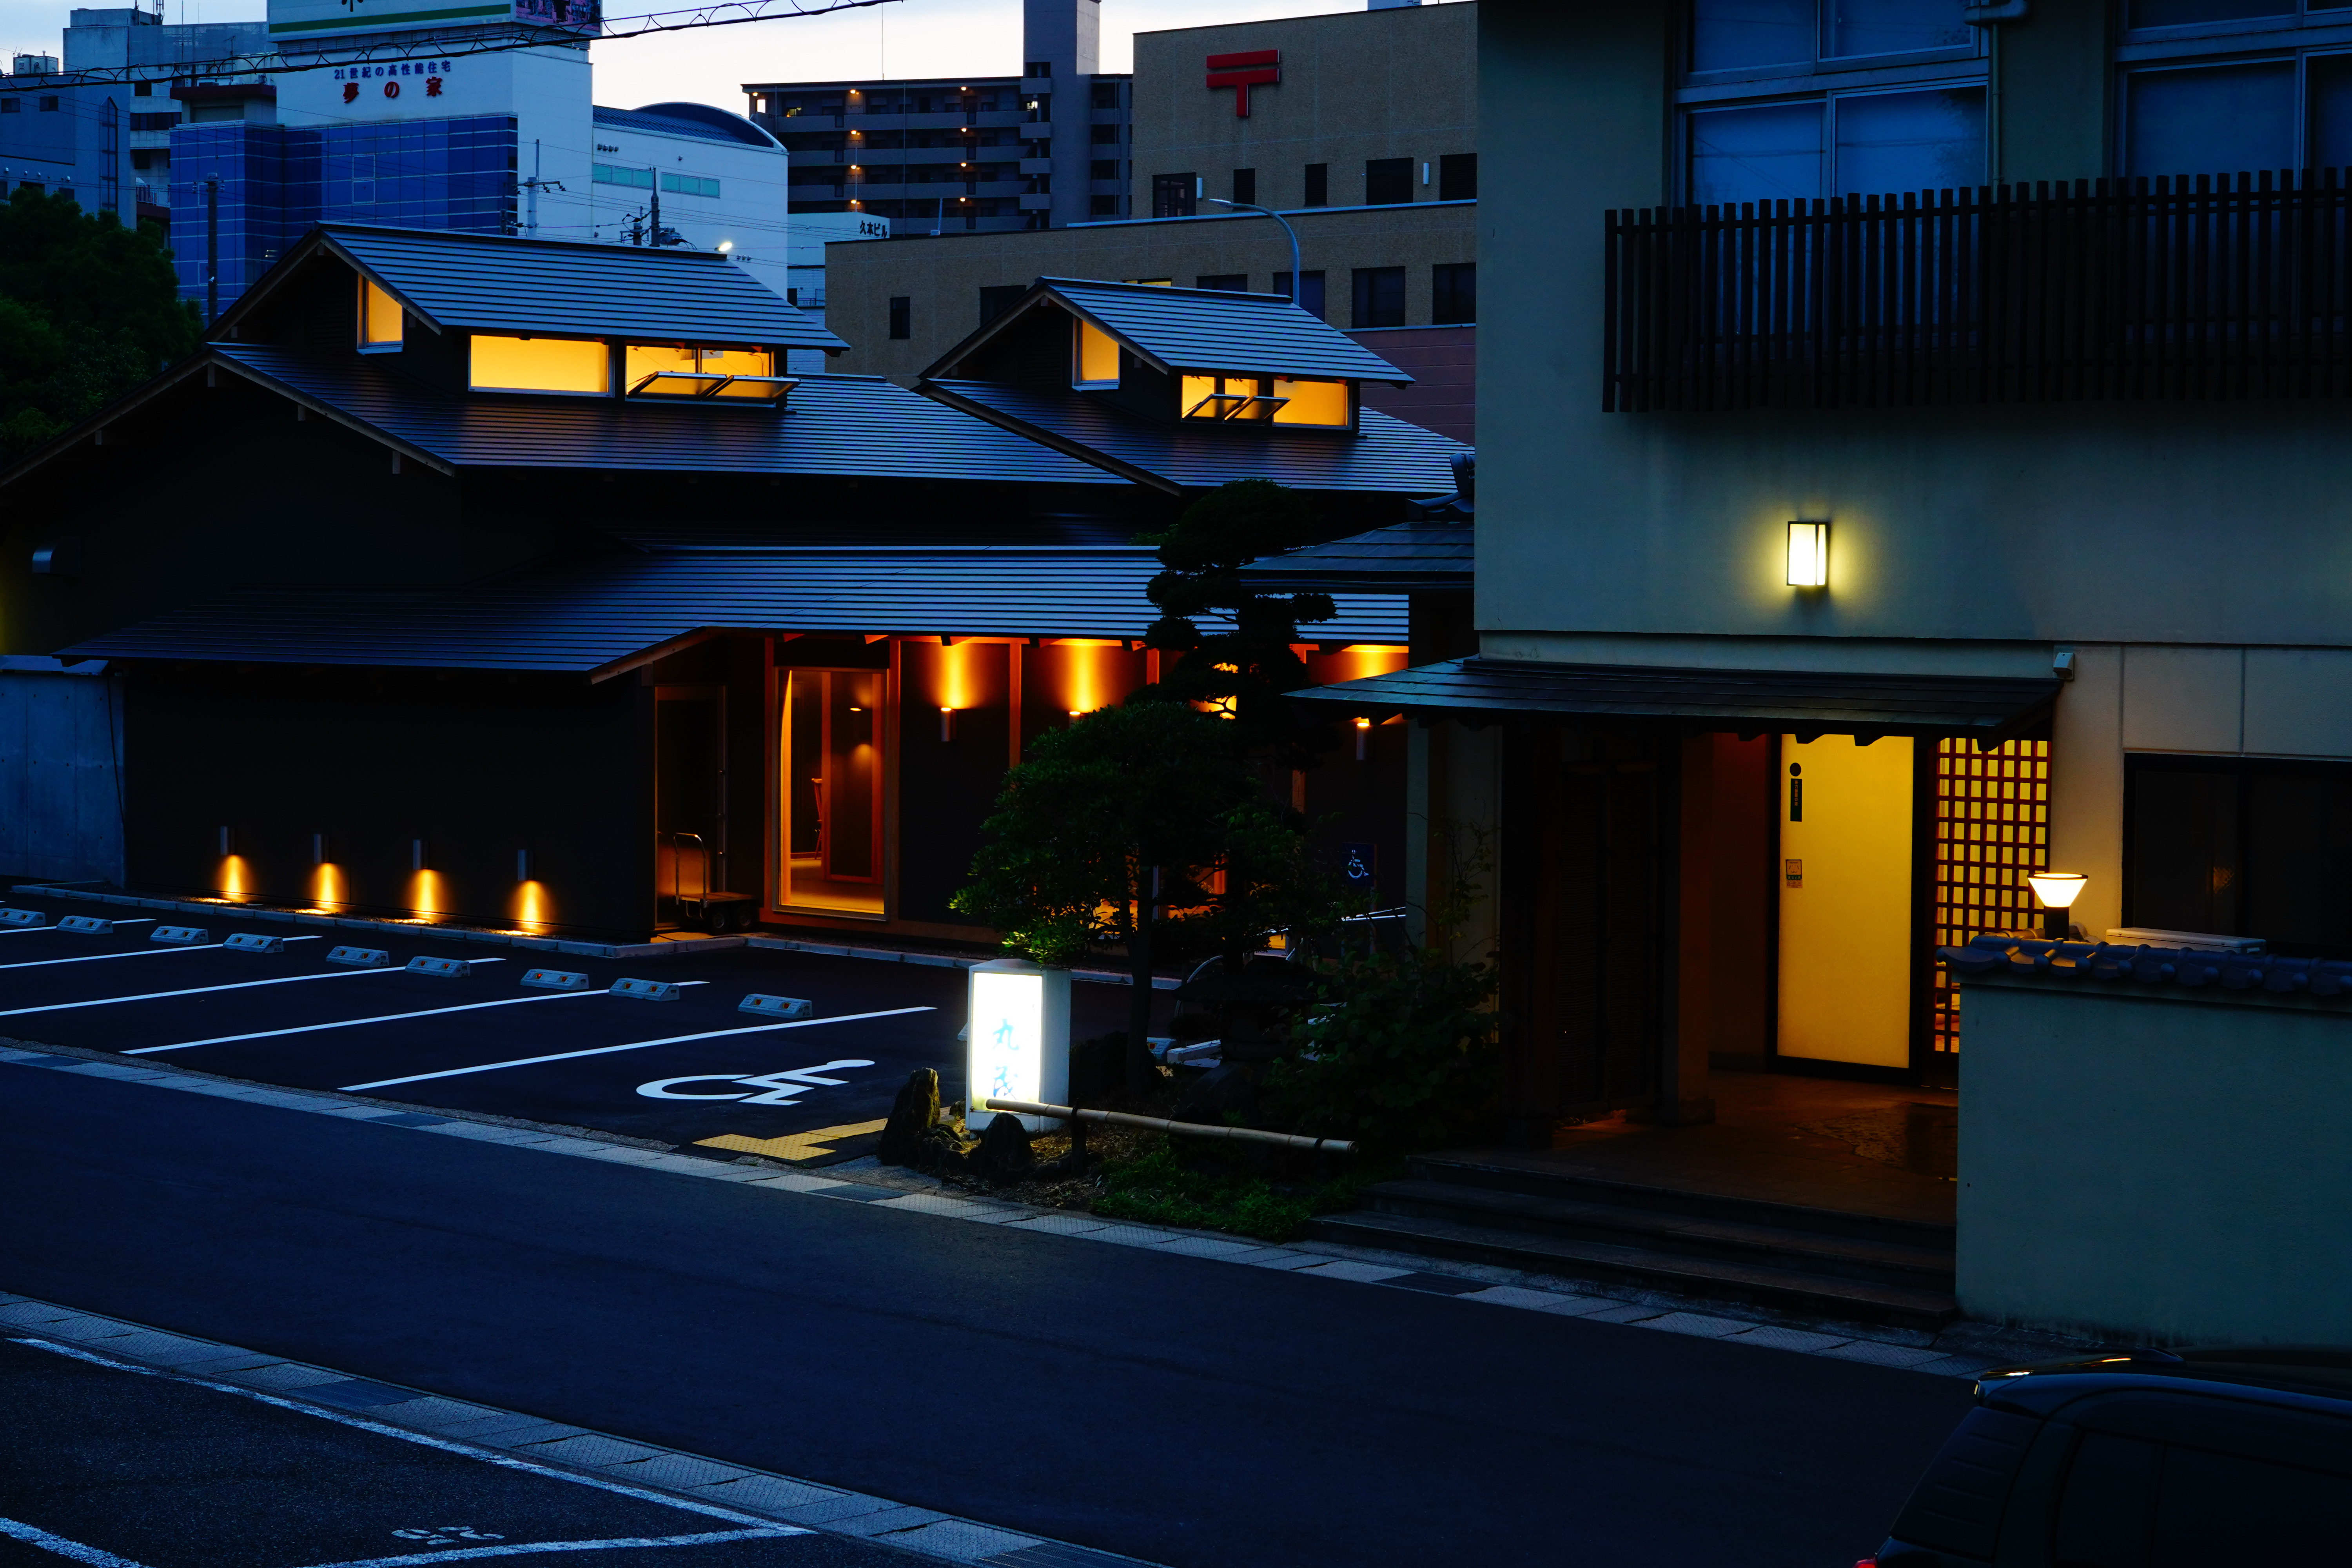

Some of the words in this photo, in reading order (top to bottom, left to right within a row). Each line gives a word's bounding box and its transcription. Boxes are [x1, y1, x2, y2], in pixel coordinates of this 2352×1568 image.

[334, 60, 451, 79] 21世紀の高性能住宅
[343, 76, 443, 103] 夢の家
